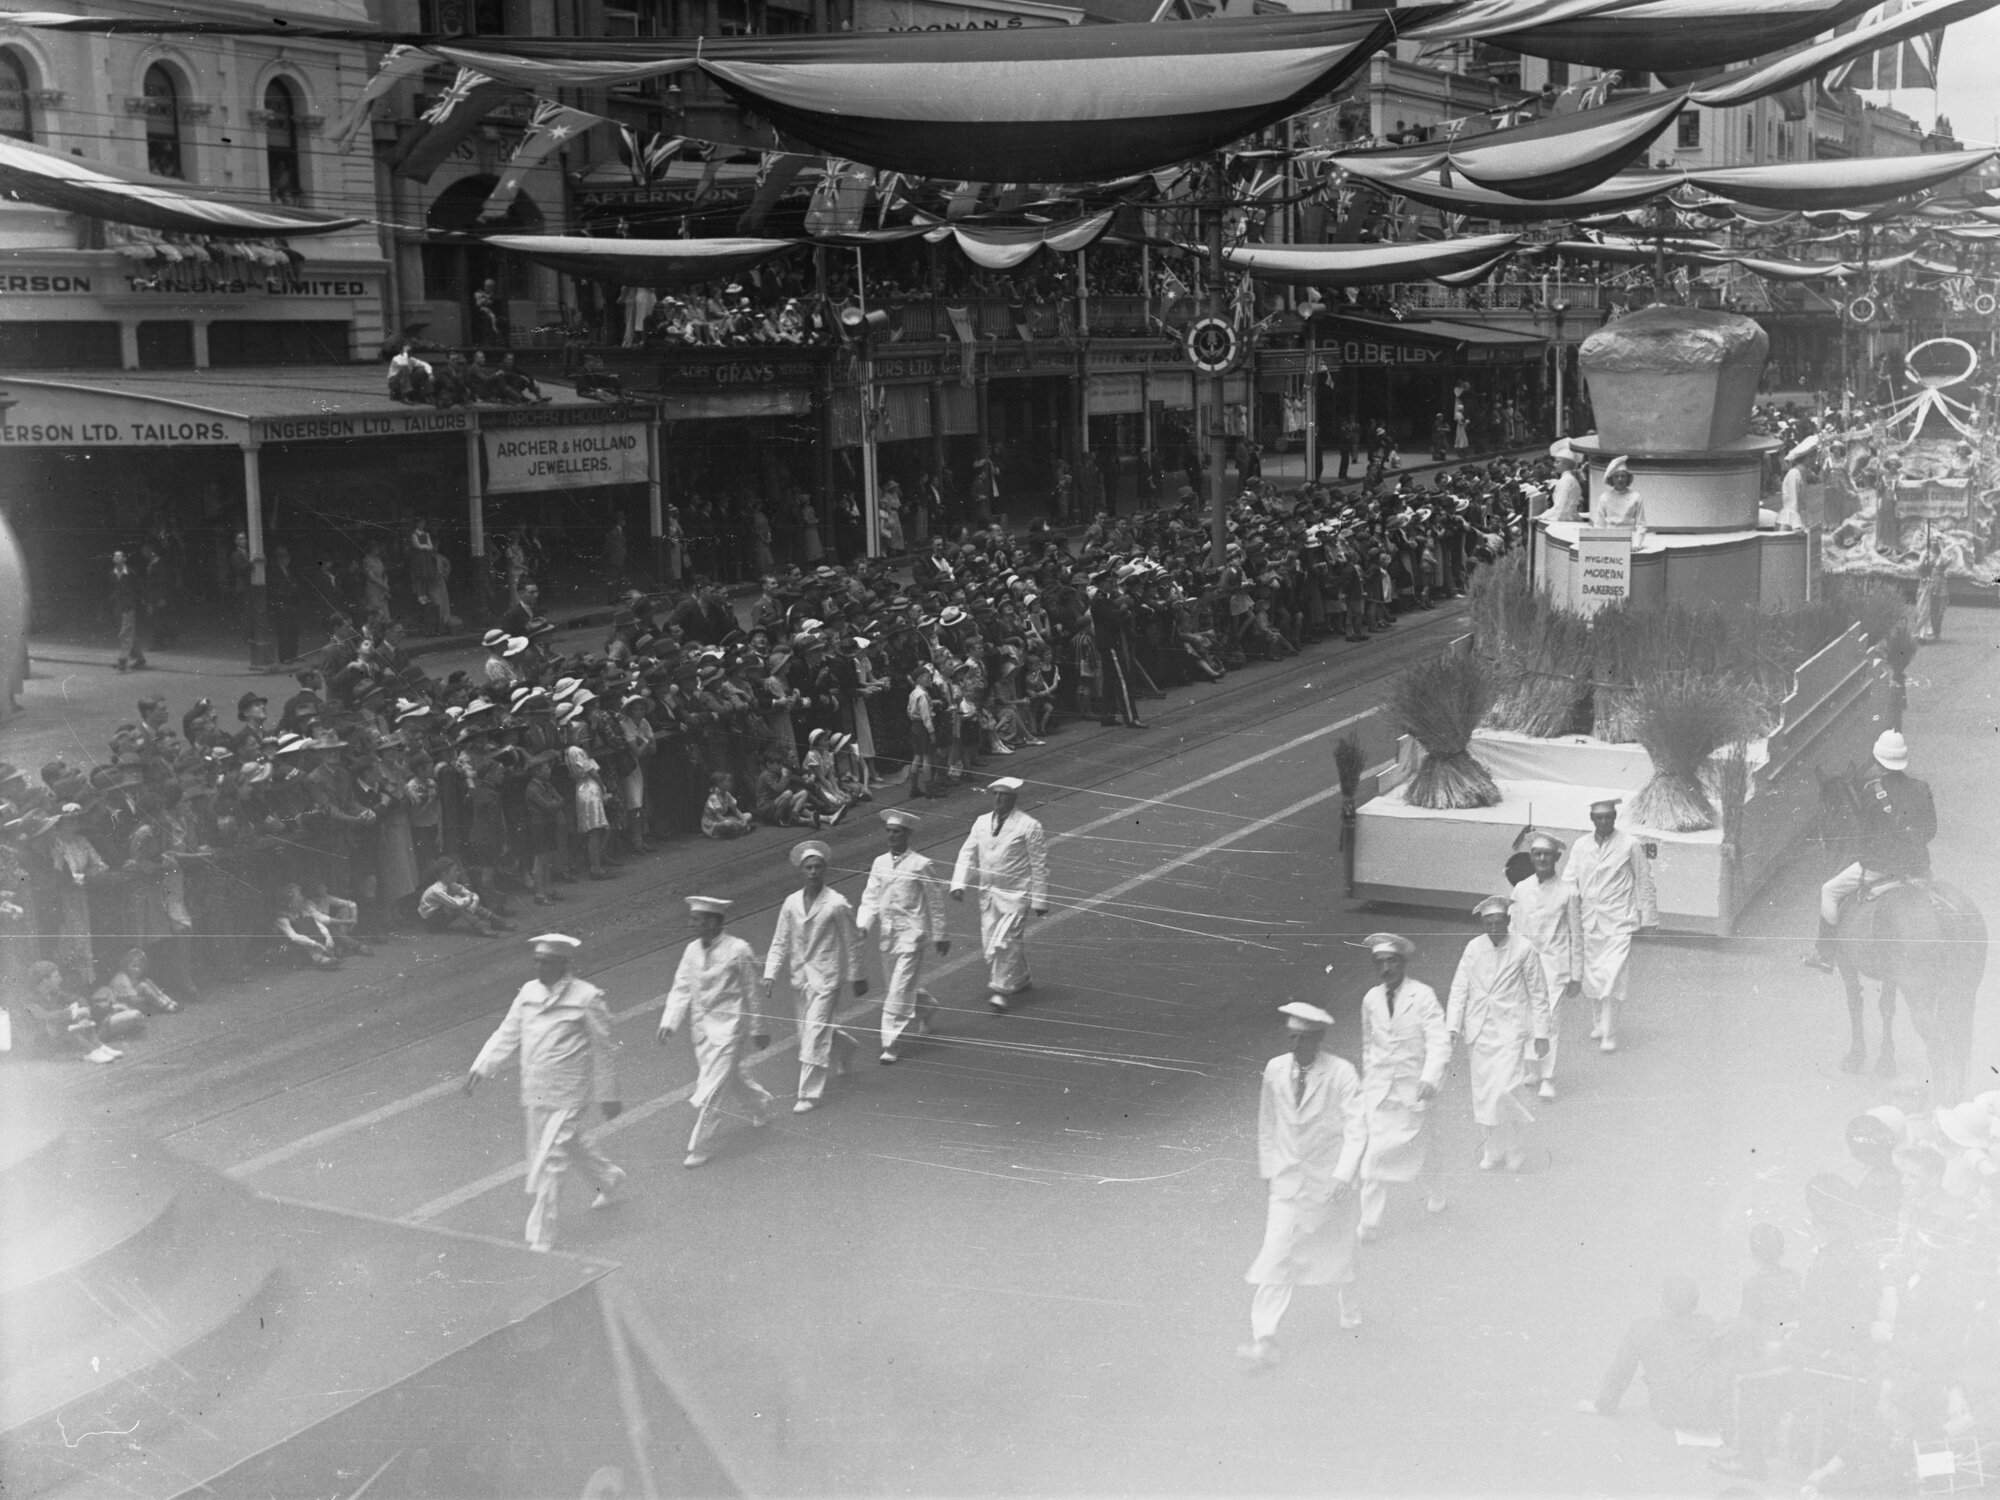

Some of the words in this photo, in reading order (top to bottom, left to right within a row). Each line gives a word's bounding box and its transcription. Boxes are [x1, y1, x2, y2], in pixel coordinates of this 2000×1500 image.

[583, 189, 738, 204] AFTERNOON
[82, 424, 121, 441] LTD.
[131, 422, 228, 441] TAILORS.
[263, 420, 353, 440] INGERSON
[361, 418, 394, 435] LTD.
[402, 413, 466, 433] TAILORS
[497, 440, 558, 458] ARCHER
[562, 442, 569, 454] &
[573, 435, 636, 453] HOLLAND
[528, 457, 612, 476] JEWELLERS.
[1582, 584, 1624, 596] BAKERIES
